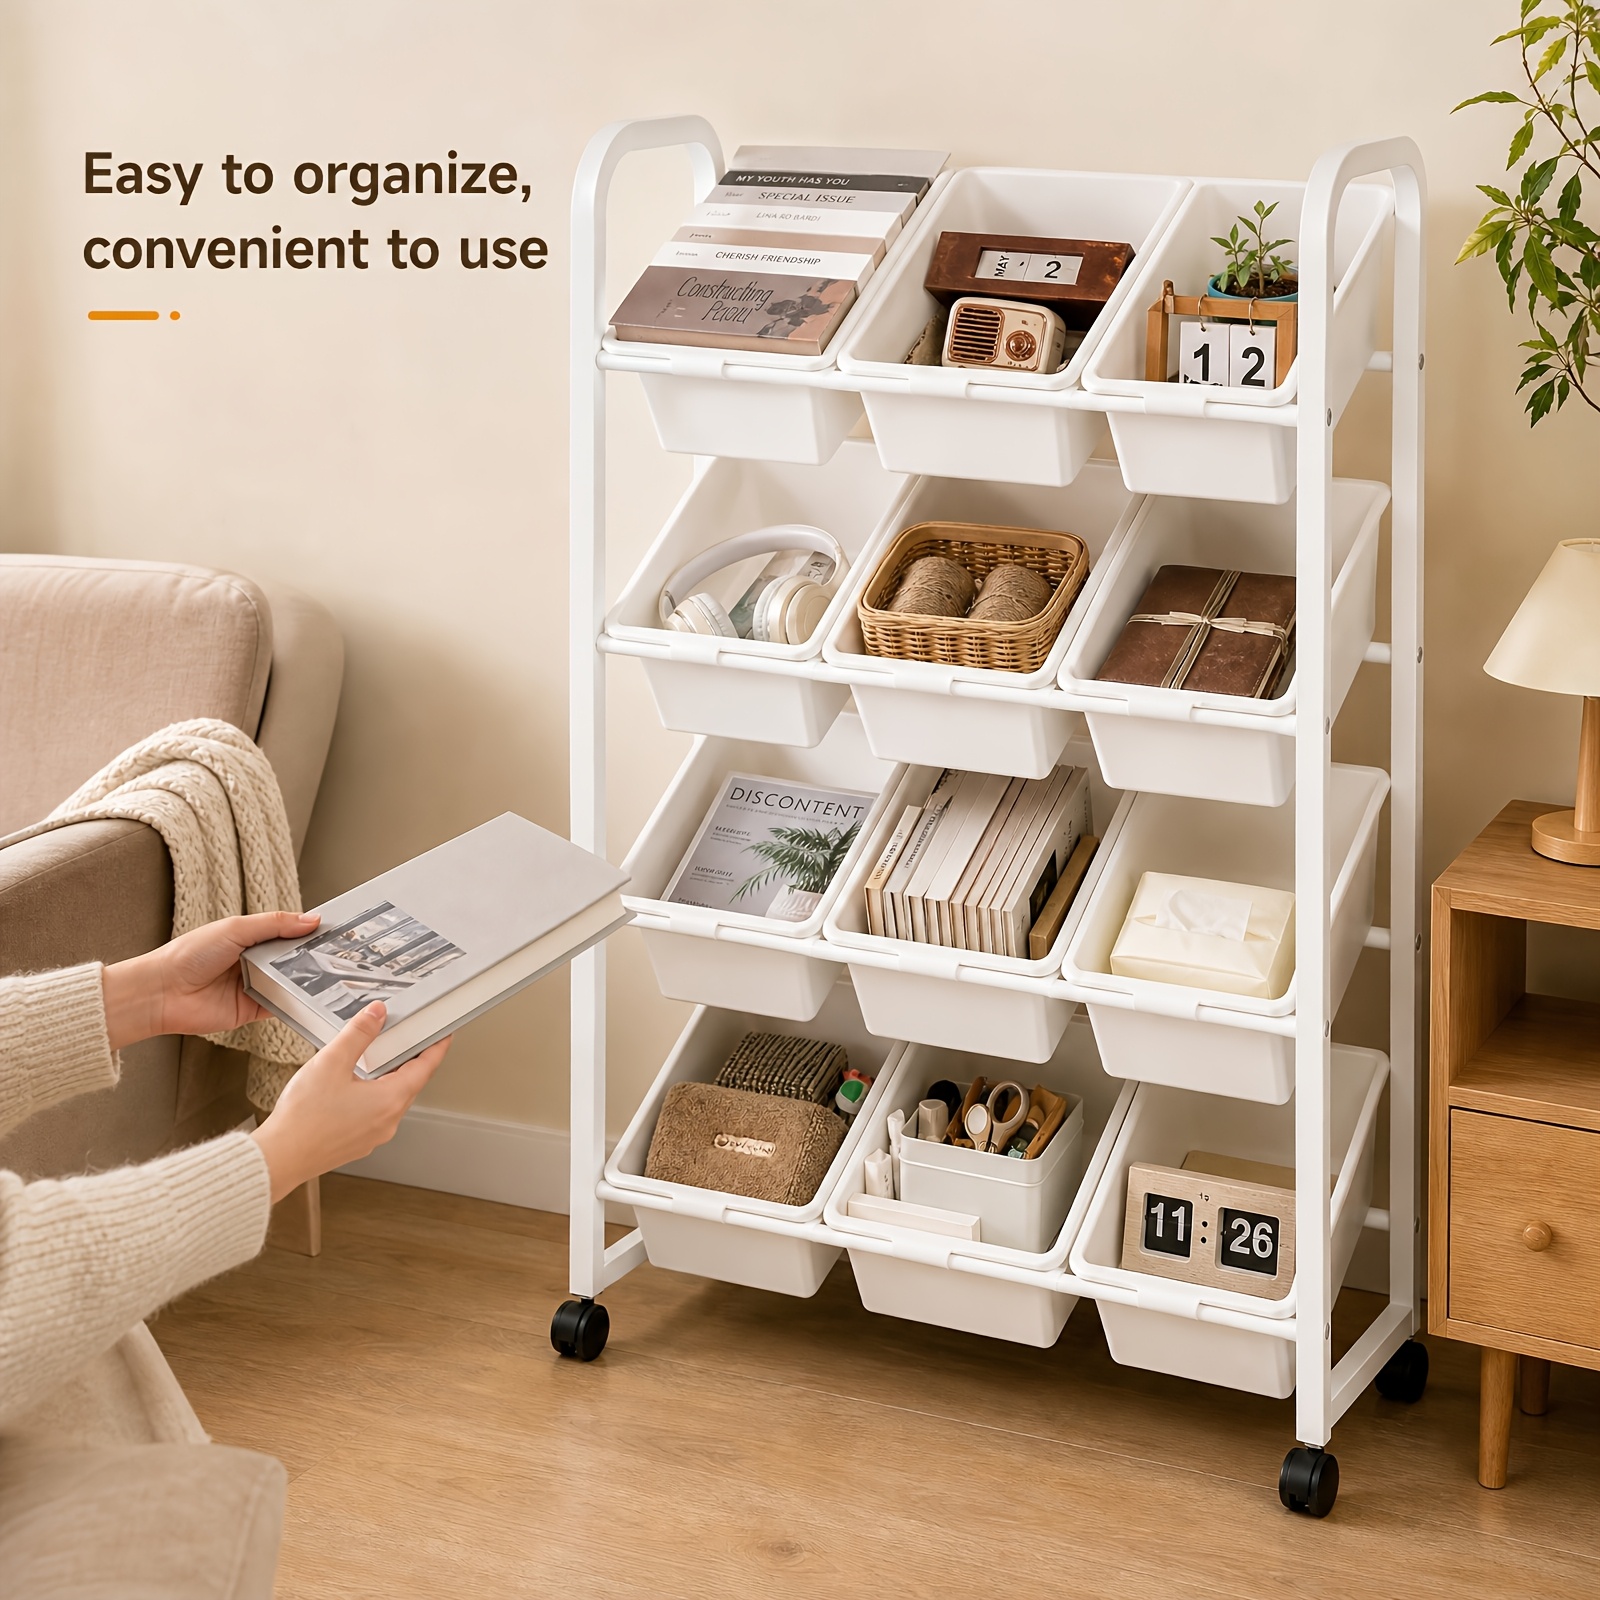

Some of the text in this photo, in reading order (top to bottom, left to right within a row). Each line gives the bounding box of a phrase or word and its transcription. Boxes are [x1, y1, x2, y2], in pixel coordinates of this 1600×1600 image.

[757, 175, 796, 184] YOUTH
[798, 177, 822, 185] HAS
[825, 178, 850, 186] YOU
[758, 192, 856, 204] SPECIAL ISSUE
[715, 251, 821, 266] CHERISH FRIENDSHIP
[994, 255, 1062, 279] MAY 2
[1193, 343, 1266, 387] 1 2
[730, 787, 865, 819] DISCONTENT
